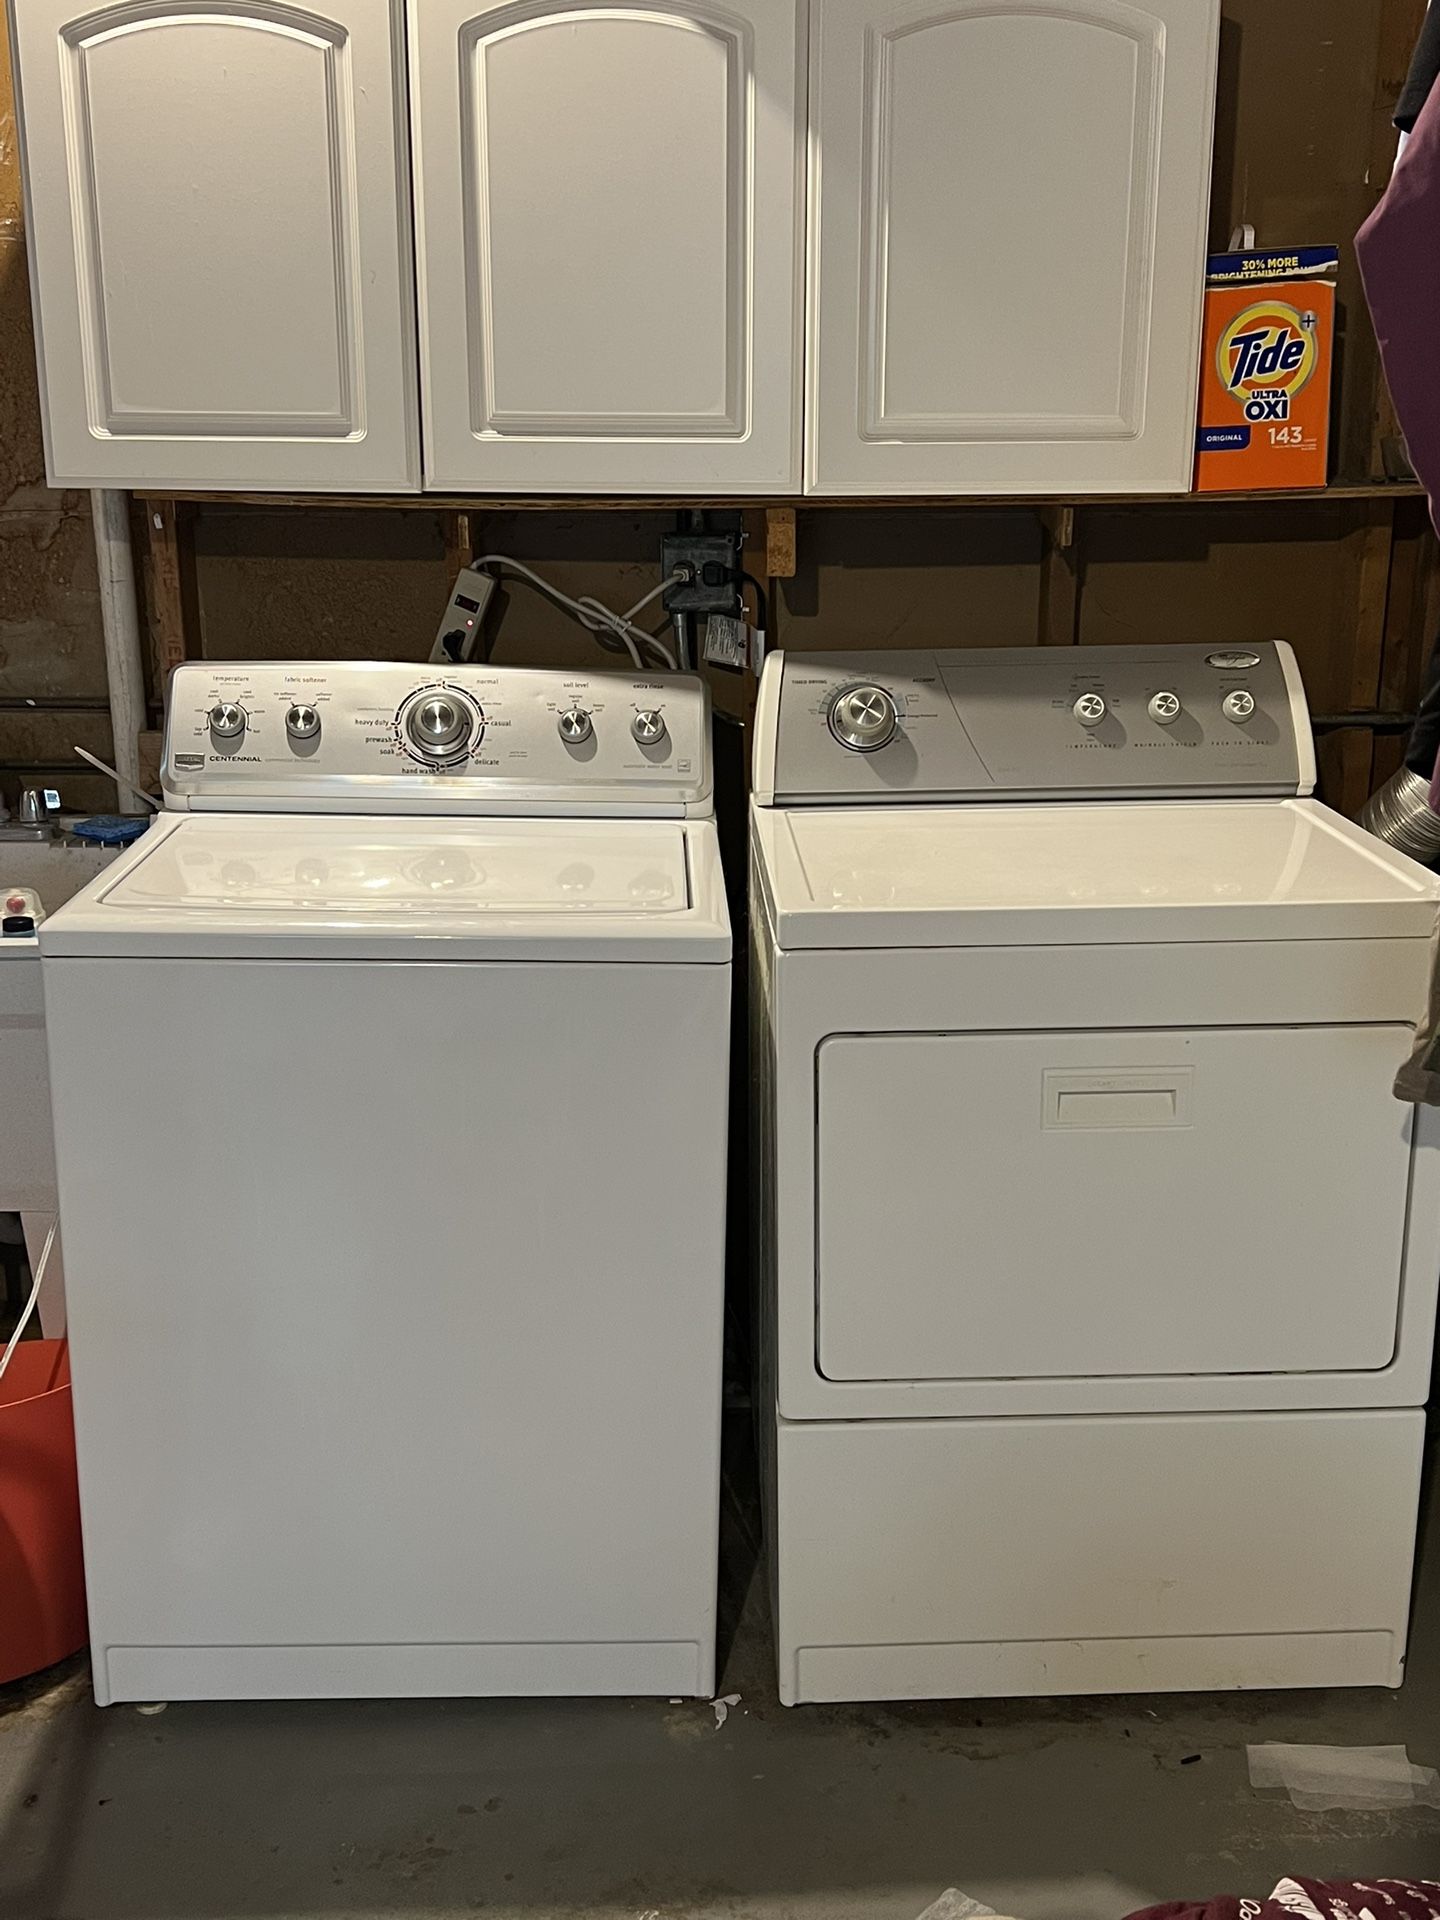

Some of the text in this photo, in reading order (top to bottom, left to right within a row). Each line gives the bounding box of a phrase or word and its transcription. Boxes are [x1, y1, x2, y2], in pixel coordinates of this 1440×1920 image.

[1242, 257, 1299, 271] 30% MORE
[1228, 326, 1307, 390] Tide
[1251, 388, 1288, 400] ULTRA
[1245, 400, 1289, 421] OXI
[1206, 426, 1302, 445] ORIGINAL 143
